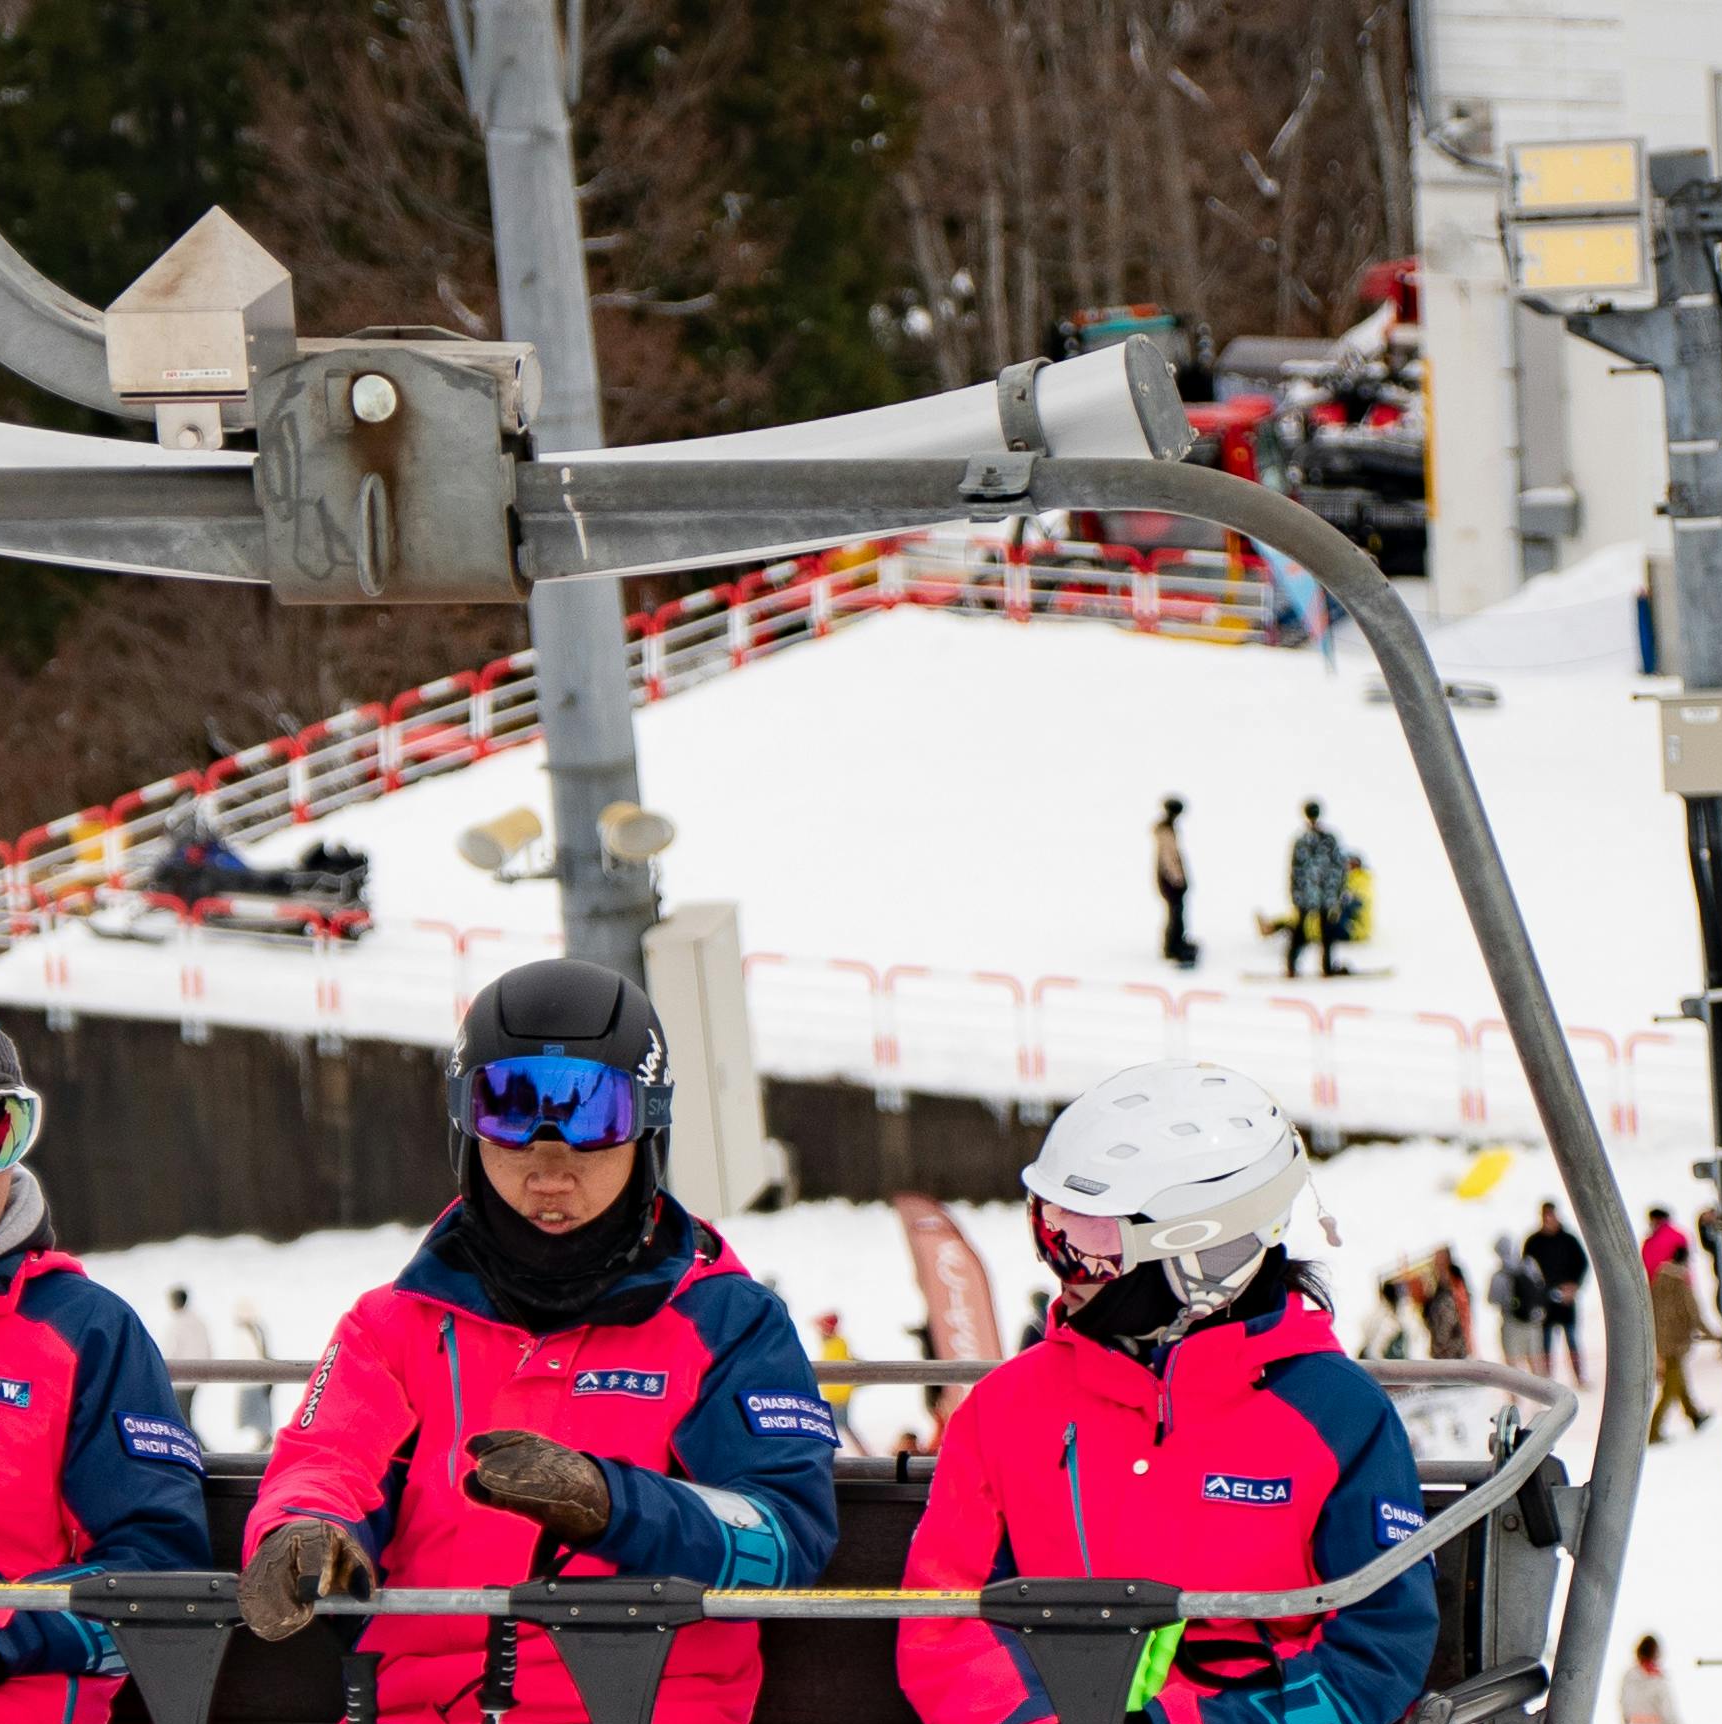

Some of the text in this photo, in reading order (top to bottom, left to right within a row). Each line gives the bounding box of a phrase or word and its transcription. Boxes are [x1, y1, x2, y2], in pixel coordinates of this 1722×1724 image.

[760, 1396, 800, 1410] NASPA
[135, 1421, 173, 1437] NASPA
[758, 1416, 837, 1440] SNOW SCHOOL
[132, 1438, 169, 1454] SNOW
[1232, 1482, 1287, 1501] ELSA
